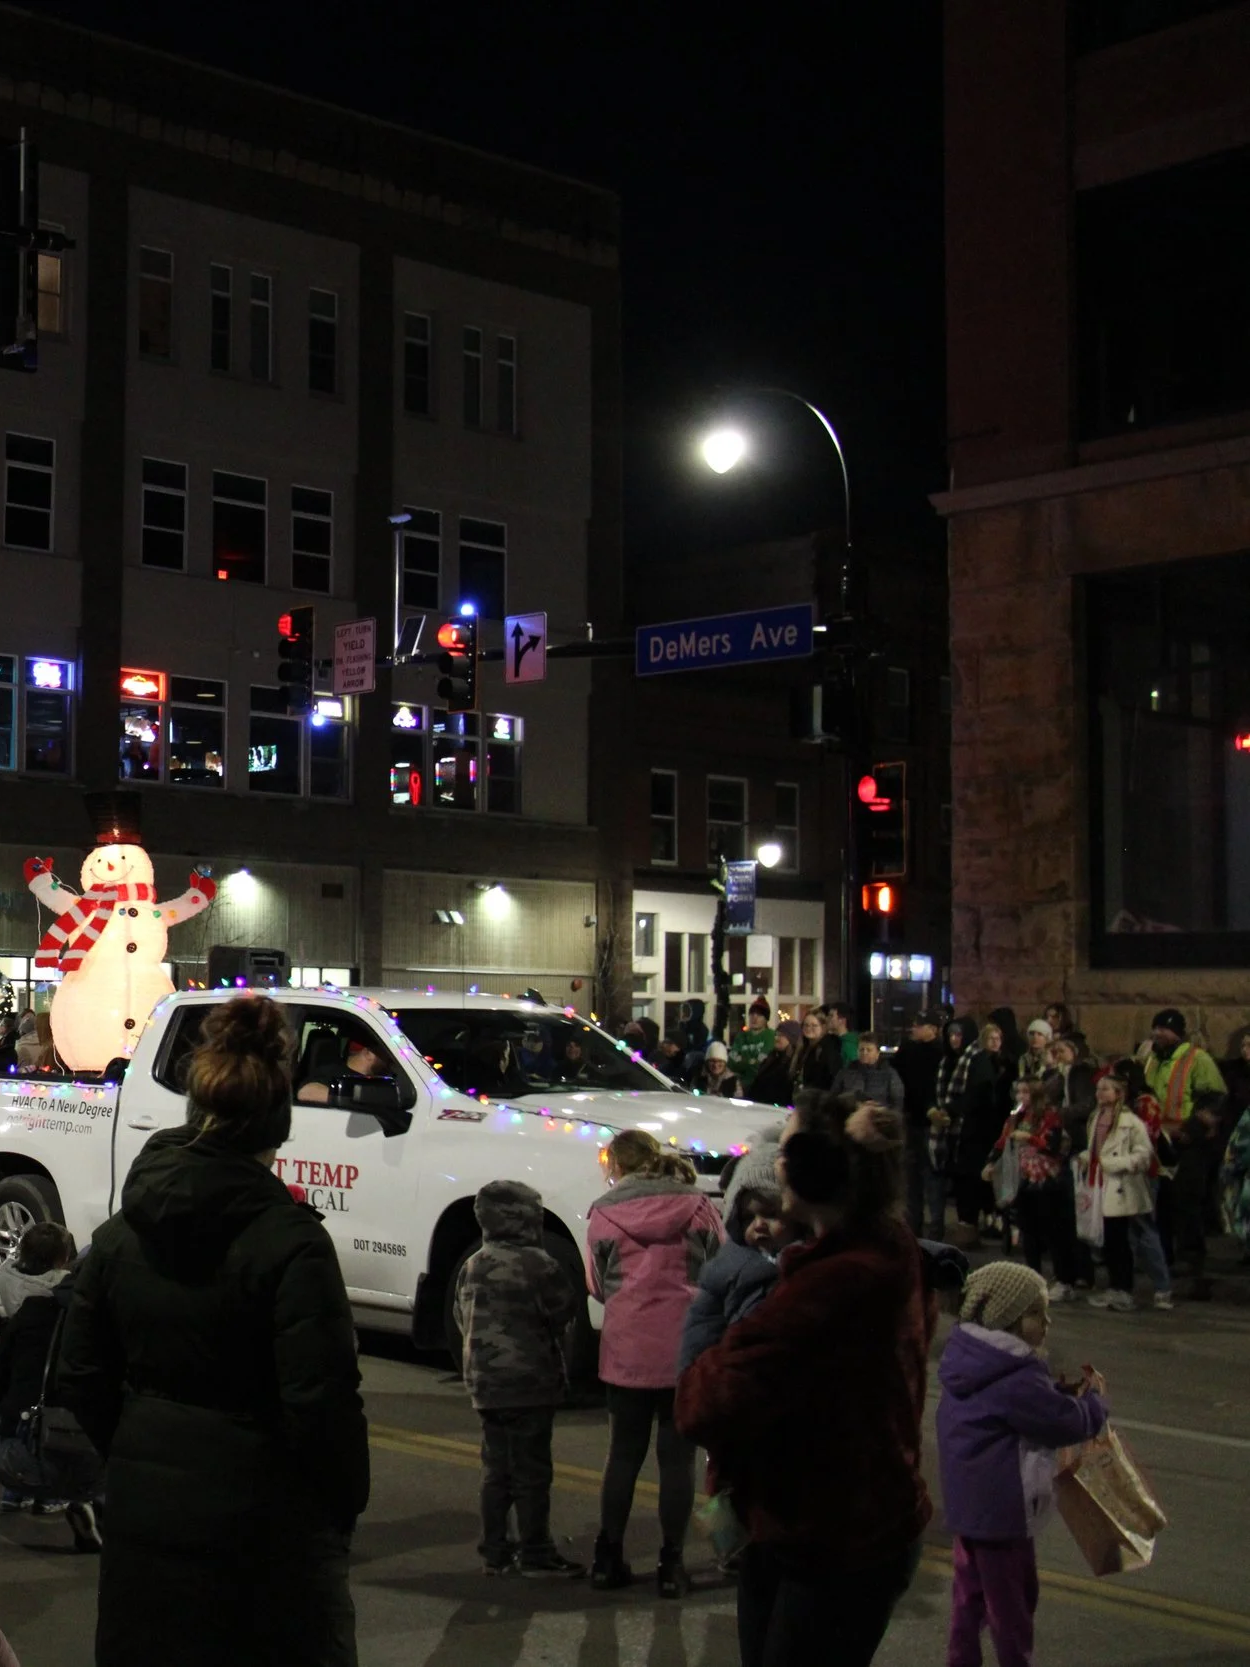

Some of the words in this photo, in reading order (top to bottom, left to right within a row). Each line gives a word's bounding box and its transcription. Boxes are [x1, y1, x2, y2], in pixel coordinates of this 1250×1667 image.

[337, 627, 352, 638] LEFT
[355, 624, 372, 634] TURN
[342, 638, 366, 651] YIELD
[649, 630, 732, 664] DeMers
[750, 621, 798, 650] Ave
[342, 665, 366, 677] YELLOW
[343, 679, 365, 689] ARROW
[11, 1095, 37, 1109] HVAC
[38, 1097, 48, 1111] To
[49, 1098, 55, 1111] A
[57, 1100, 78, 1114] New
[79, 1101, 113, 1119] Degree
[293, 1159, 359, 1190] TEMP
[353, 1238, 371, 1252] DOT
